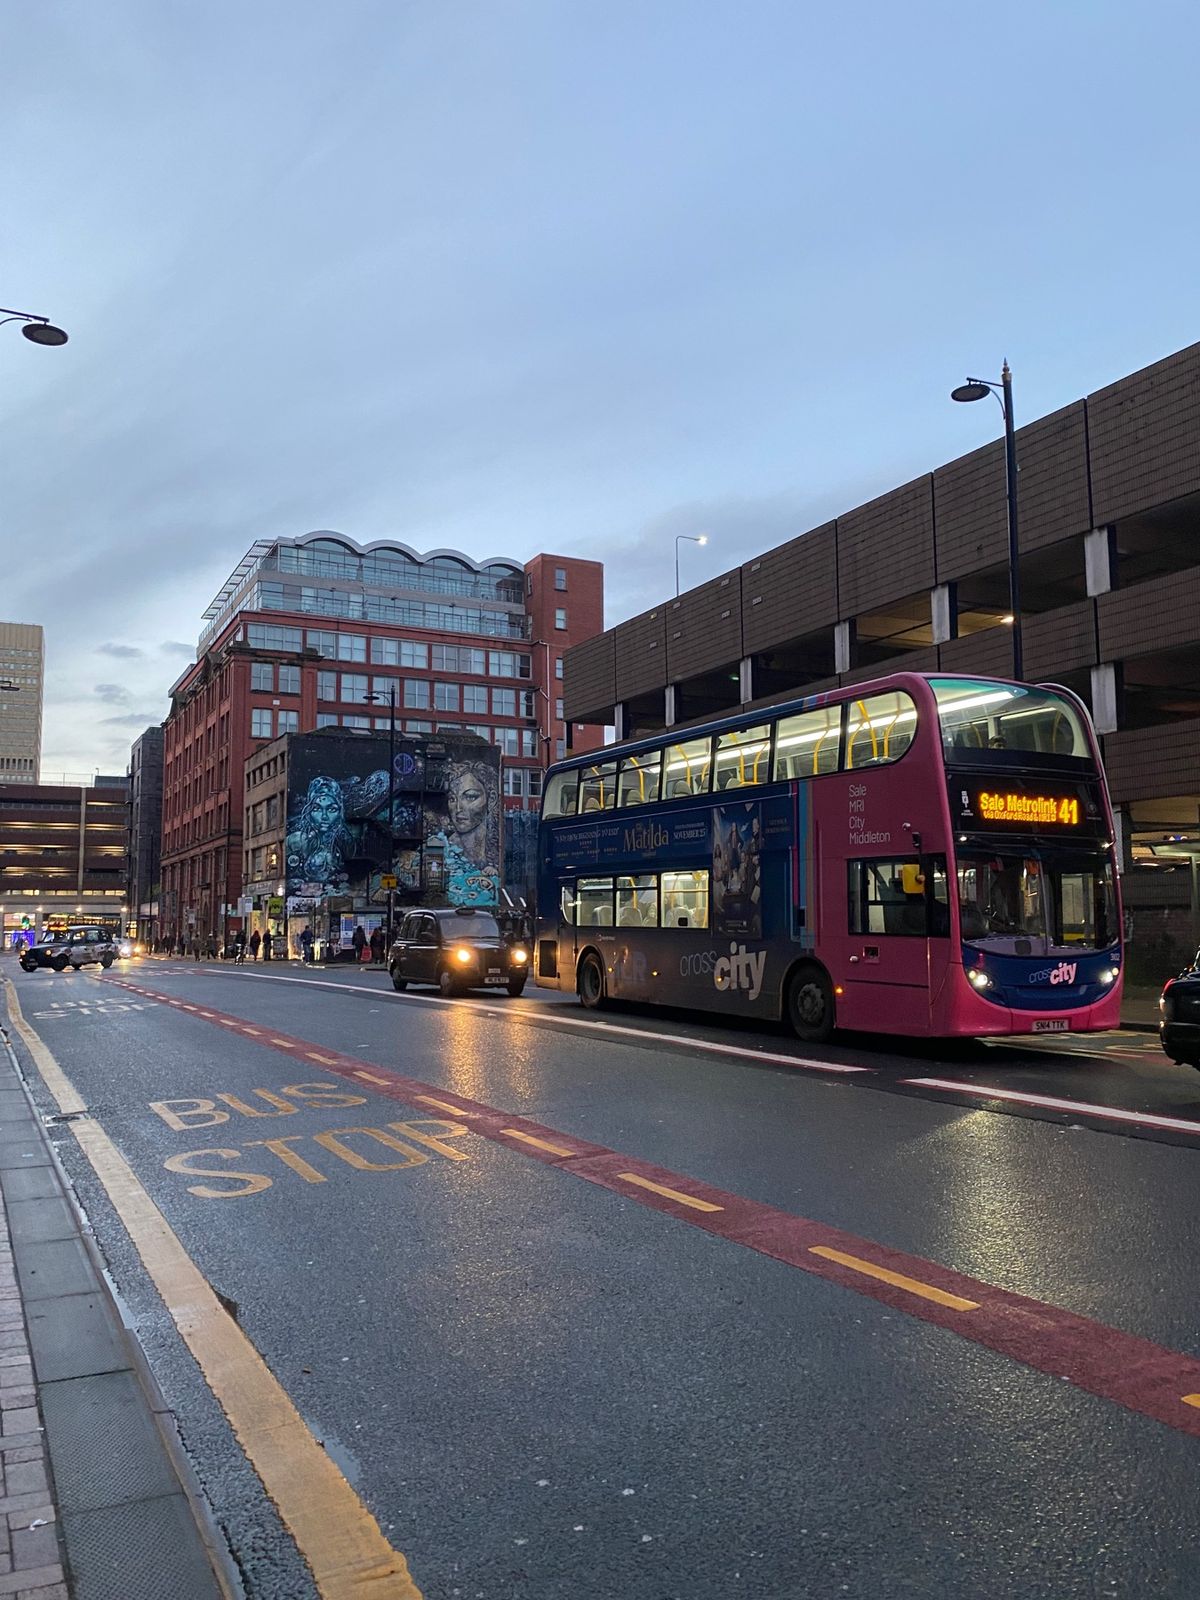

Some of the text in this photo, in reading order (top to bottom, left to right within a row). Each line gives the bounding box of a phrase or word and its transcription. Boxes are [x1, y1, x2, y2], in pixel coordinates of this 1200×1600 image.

[849, 784, 867, 797] Sale
[849, 799, 864, 812] MRI
[980, 792, 1004, 810] Sale
[1007, 795, 1057, 813] Metrolink
[1059, 798, 1078, 824] 41
[849, 816, 865, 831] City
[623, 822, 669, 853] Matilda
[849, 831, 891, 845] Middleton
[1035, 1020, 1065, 1031] SN14 TTK
[148, 1083, 367, 1132] BUS
[163, 1119, 470, 1199] STOP
